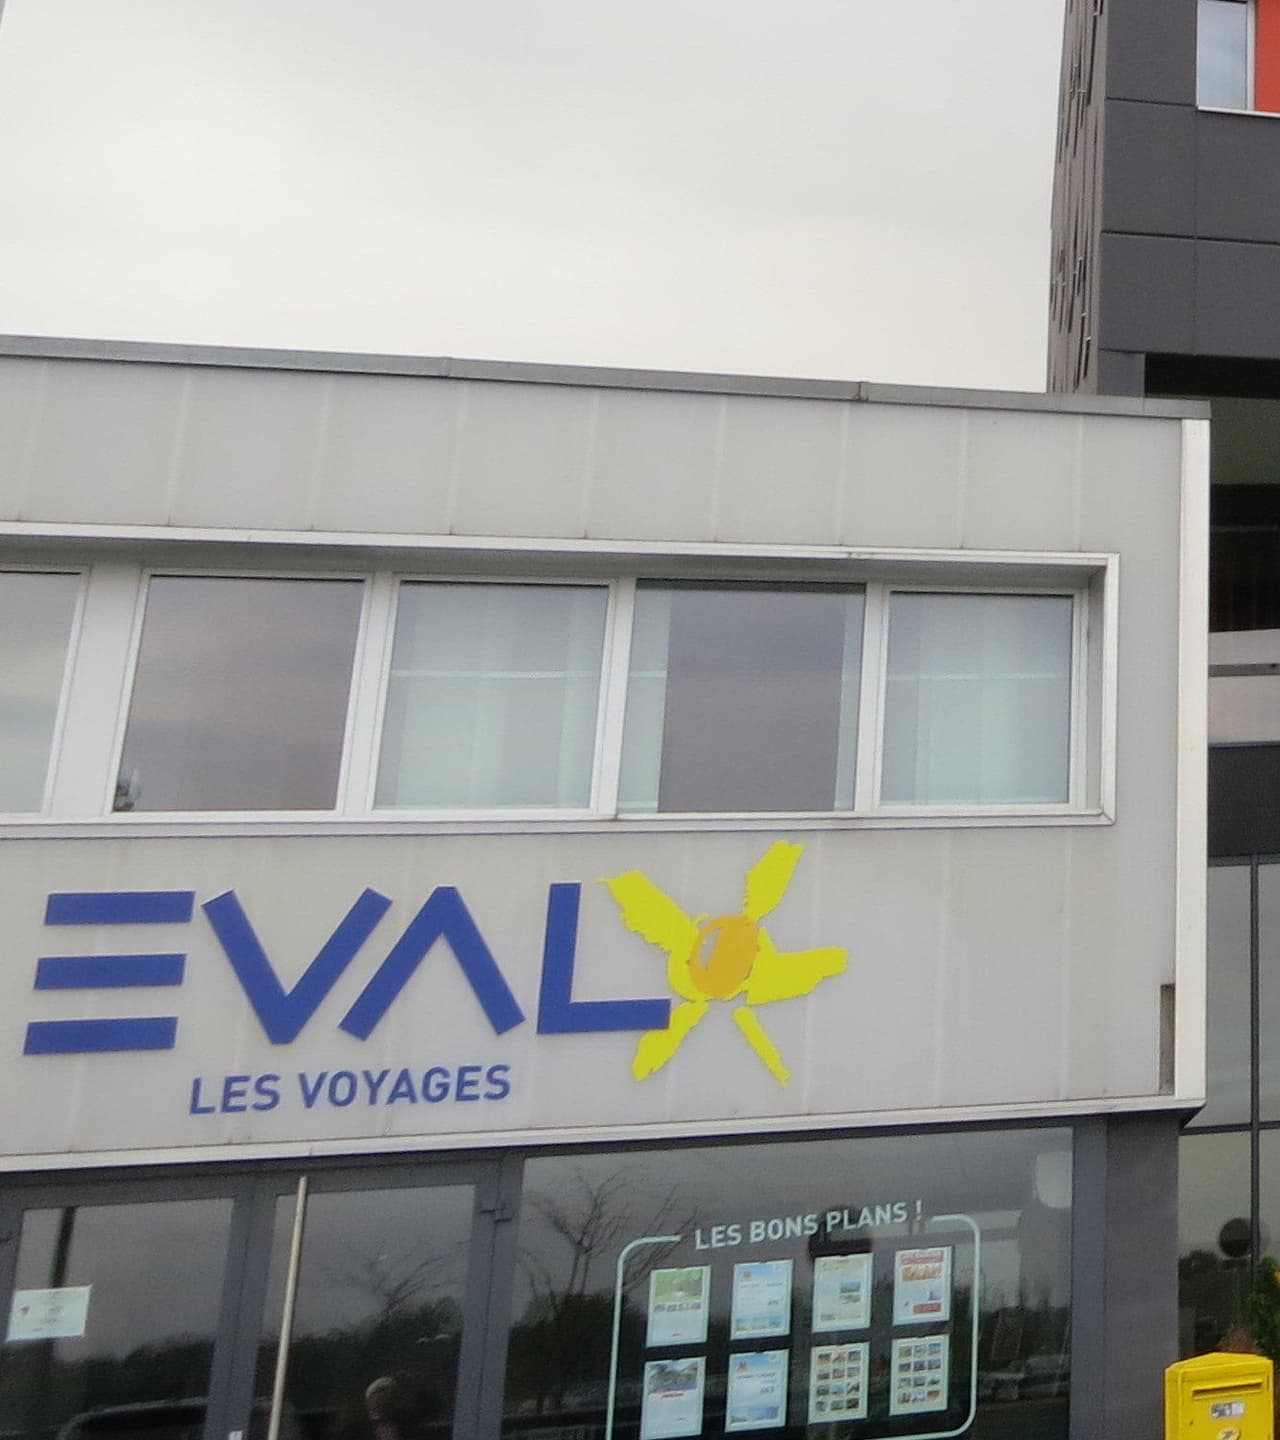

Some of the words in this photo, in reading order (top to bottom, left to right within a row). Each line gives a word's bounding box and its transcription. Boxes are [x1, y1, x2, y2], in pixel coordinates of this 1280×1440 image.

[22, 881, 672, 1056] EVAL
[190, 1072, 281, 1115] LES
[299, 1063, 513, 1108] VOYAGES
[694, 1223, 742, 1251] LES
[749, 1213, 819, 1243] BONS
[825, 1201, 908, 1233] PLANS
